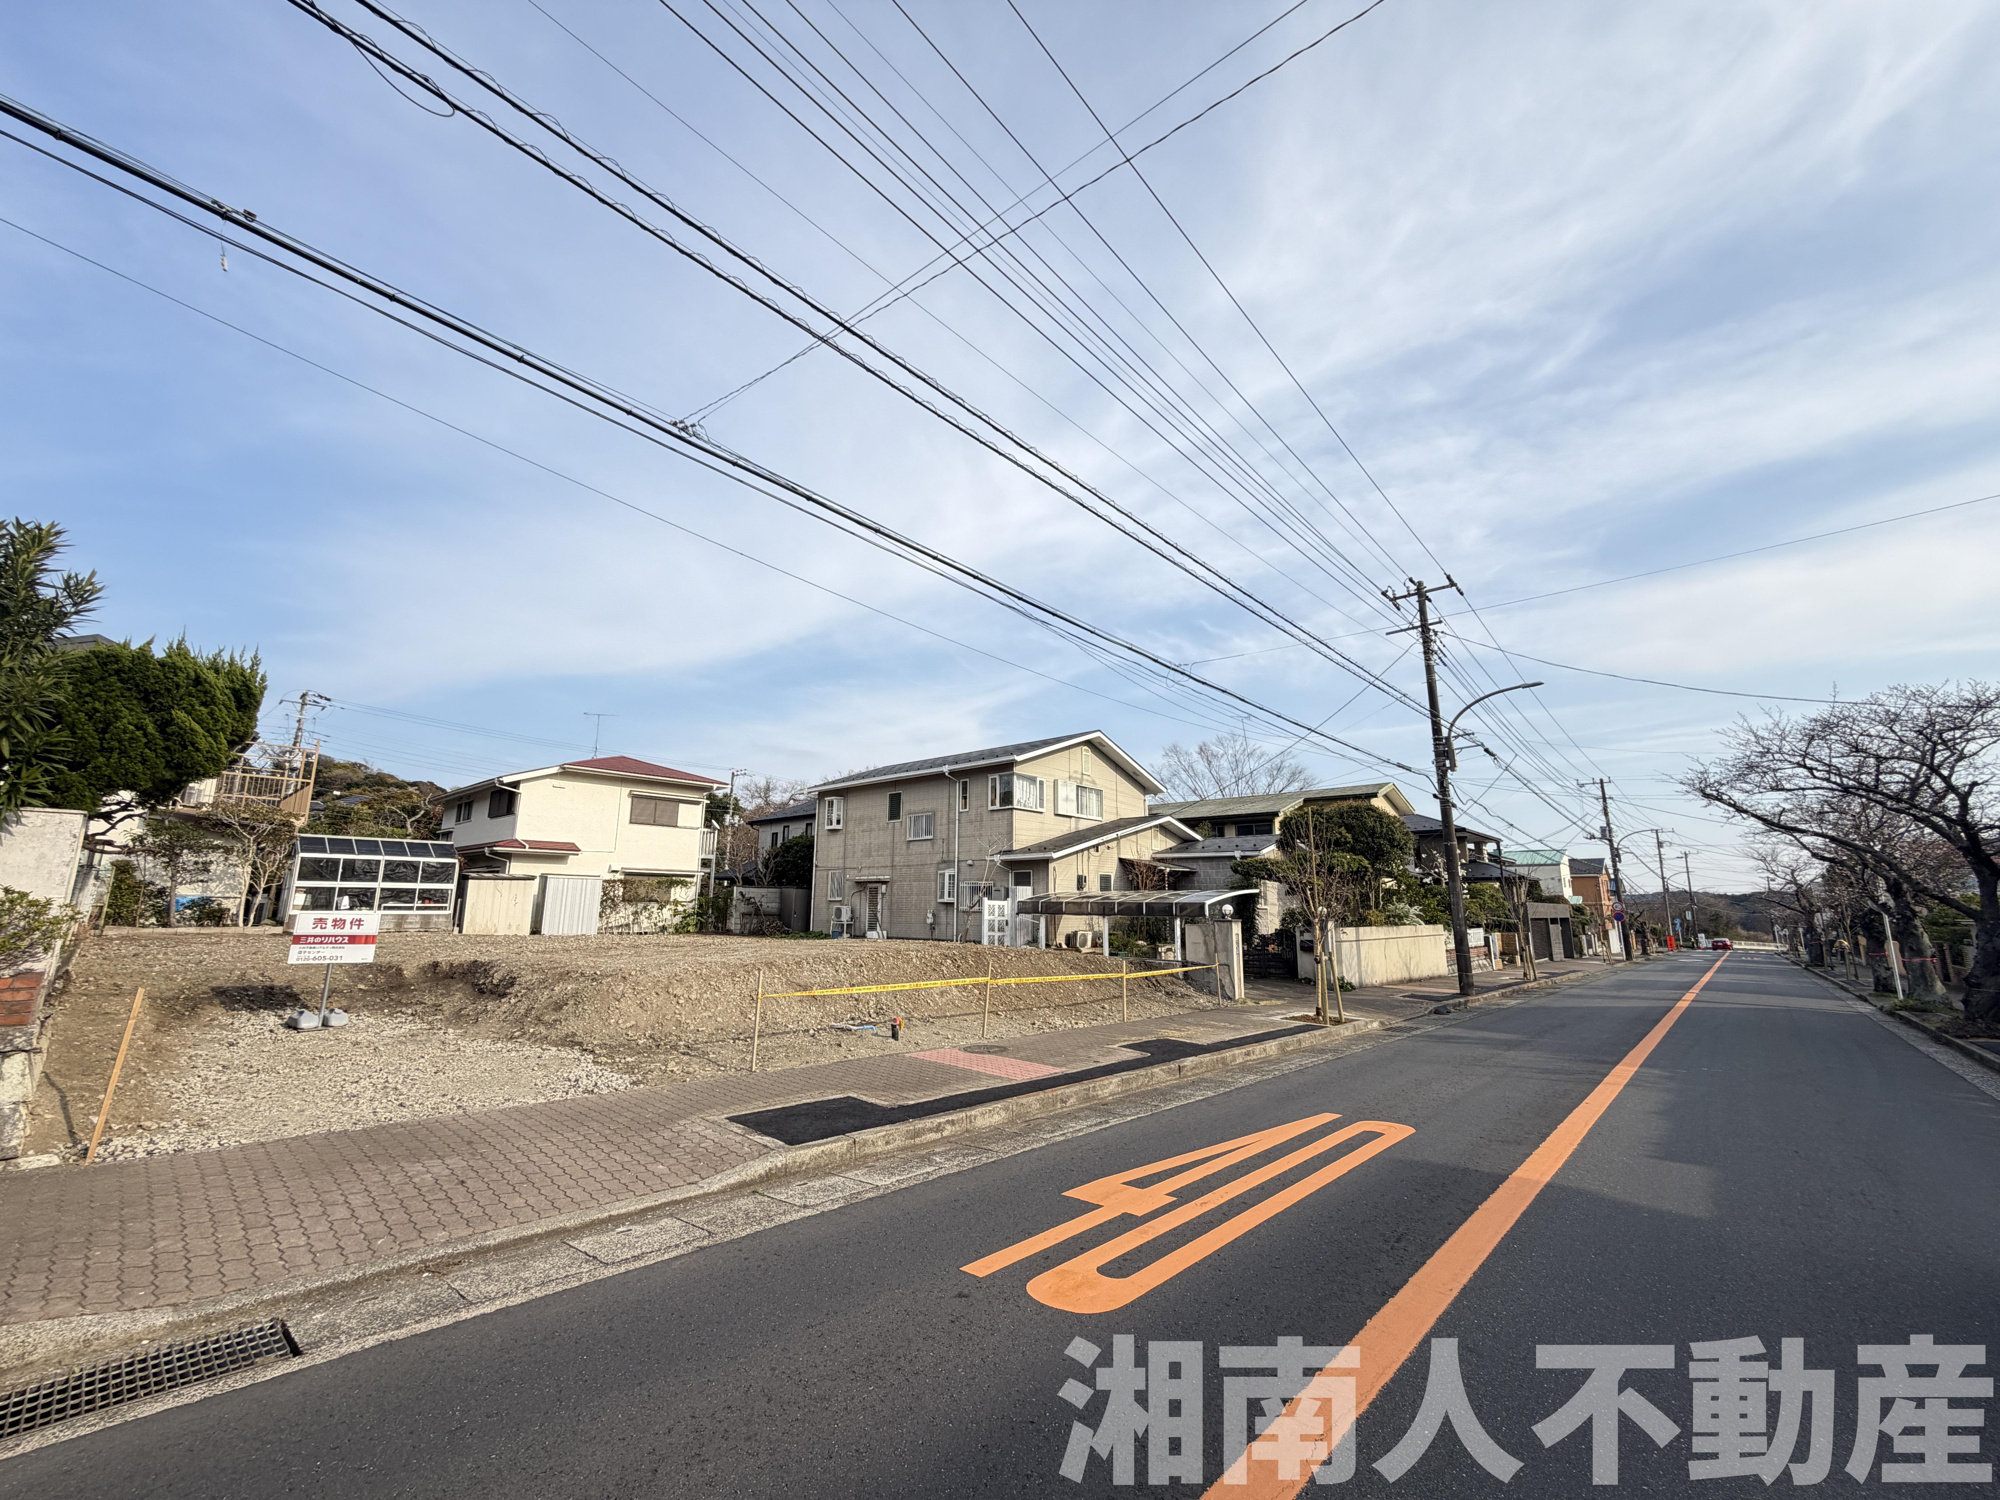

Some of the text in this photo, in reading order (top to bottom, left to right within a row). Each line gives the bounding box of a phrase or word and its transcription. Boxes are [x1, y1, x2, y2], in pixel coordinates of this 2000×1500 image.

[312, 917, 364, 930] 売物件
[299, 936, 349, 944] 三井のリハウス
[960, 1113, 1416, 1313] 40
